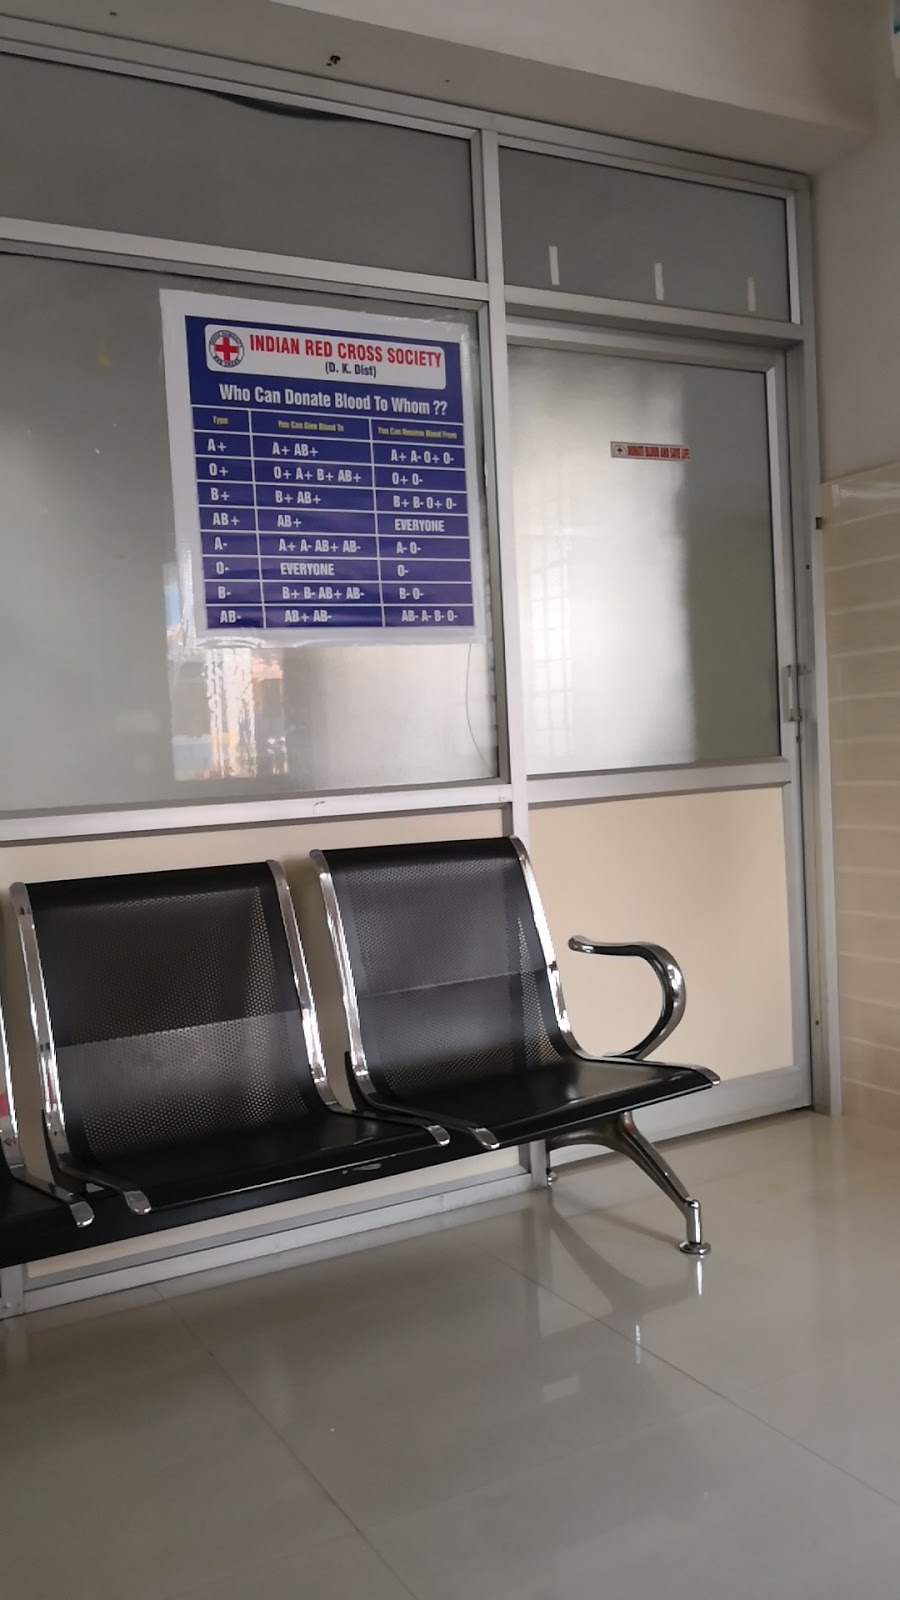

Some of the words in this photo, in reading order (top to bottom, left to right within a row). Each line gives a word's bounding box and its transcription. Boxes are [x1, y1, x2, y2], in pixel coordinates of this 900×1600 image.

[250, 335, 300, 355] INDIAN
[305, 339, 333, 358] RED
[337, 343, 383, 362] CROSS
[387, 347, 442, 368] SOCIETY
[325, 361, 339, 375] (D.
[342, 363, 352, 374] K.
[354, 364, 377, 378] Dist)
[219, 383, 251, 402] Who
[254, 386, 281, 404] Can
[284, 388, 331, 408] Donate
[334, 392, 371, 410] Blood
[373, 395, 388, 412] To
[391, 397, 430, 415] Whom
[433, 400, 448, 415] ??
[207, 438, 227, 452] A+
[272, 442, 290, 455] A+
[294, 443, 319, 457] AB+
[391, 449, 407, 462] A+
[410, 450, 422, 462] A-
[423, 451, 439, 464] O+
[443, 452, 454, 464] O-
[208, 462, 229, 477] O+
[273, 466, 292, 479] O+
[295, 467, 313, 480] A+
[317, 468, 334, 481] B+
[337, 470, 362, 483] AB+
[391, 472, 408, 485] O+
[411, 473, 423, 485] O-
[210, 487, 230, 501] B+
[275, 490, 293, 504] B+
[297, 491, 321, 504] AB+
[393, 495, 409, 508] B+
[412, 496, 424, 509] B-
[426, 497, 442, 509] O+
[445, 497, 457, 510] O-
[212, 512, 240, 526] AB+
[277, 514, 302, 528] AB+
[394, 518, 445, 532] EVERYONE
[214, 536, 228, 550] A-
[278, 538, 296, 552] A+
[300, 538, 313, 552] A-
[314, 539, 339, 553] AB+
[342, 540, 361, 553] AB-
[396, 541, 408, 554] A-
[409, 541, 421, 554] O-
[215, 561, 230, 575] O-
[280, 562, 336, 576] EVERYONE
[397, 564, 409, 577] O-
[217, 586, 232, 599] B-
[282, 586, 300, 600] B+
[303, 586, 316, 600] B-
[318, 586, 342, 600] AB+
[345, 586, 365, 600] AB-
[399, 587, 411, 600] B-
[412, 587, 424, 600] O-
[219, 610, 242, 623] AB-
[284, 609, 310, 623] AB+
[313, 609, 333, 623] AB-
[401, 609, 419, 622] AB-
[421, 609, 432, 622] A-
[433, 609, 445, 622] B-
[446, 609, 458, 622] O-
